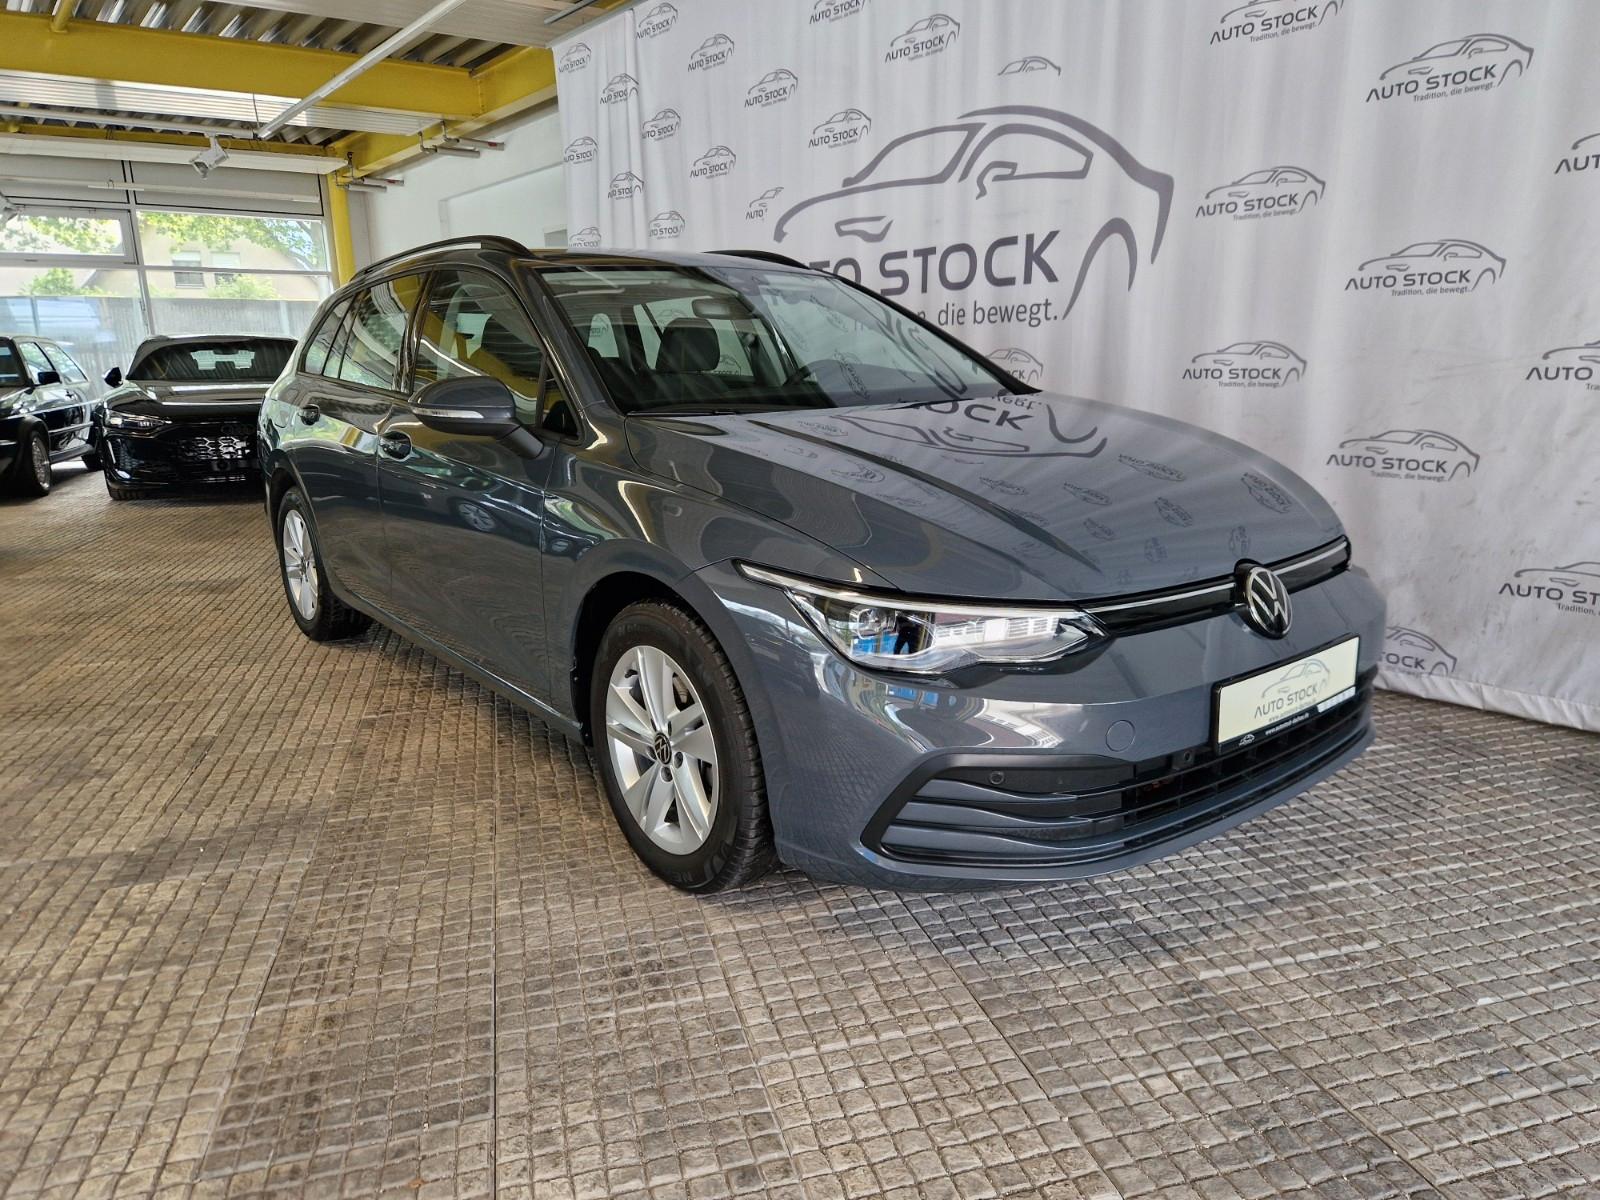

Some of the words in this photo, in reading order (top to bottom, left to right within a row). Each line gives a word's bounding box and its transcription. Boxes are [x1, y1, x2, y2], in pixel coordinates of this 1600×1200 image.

[809, 9, 831, 24] AUTO
[1210, 22, 1255, 45] AUTO
[1261, 5, 1319, 32] STOCK
[885, 46, 911, 63] AUTO
[913, 34, 945, 54] STOCK
[687, 60, 704, 72] AUTO
[705, 51, 726, 64] STOCK
[1366, 80, 1419, 103] AUTO
[1426, 63, 1498, 91] STOCK
[744, 95, 763, 108] AUTO
[764, 86, 788, 101] STOCK
[808, 135, 831, 149] AUTO
[832, 127, 859, 143] STOCK
[689, 167, 708, 178] AUTO
[708, 161, 729, 174] STOCK
[1554, 153, 1600, 175] AUT
[745, 208, 764, 220] AUTO
[1195, 201, 1238, 218] AUTO
[1244, 192, 1299, 212] STOCK
[879, 230, 1061, 297] STOCK
[1345, 275, 1397, 291] AUTO
[1402, 269, 1472, 287] STOCK
[938, 302, 966, 326] die
[973, 298, 1059, 328] bewegt.
[1182, 367, 1223, 380] AUTO
[1228, 367, 1282, 380] STOCK
[1526, 366, 1594, 381] AUTO
[1326, 454, 1376, 469] AUTO
[1381, 457, 1448, 473] STOCK
[1499, 582, 1564, 601] AUTO
[1572, 590, 1600, 606] ST
[1254, 697, 1285, 719] AUTO
[1287, 682, 1318, 706] STOCK
